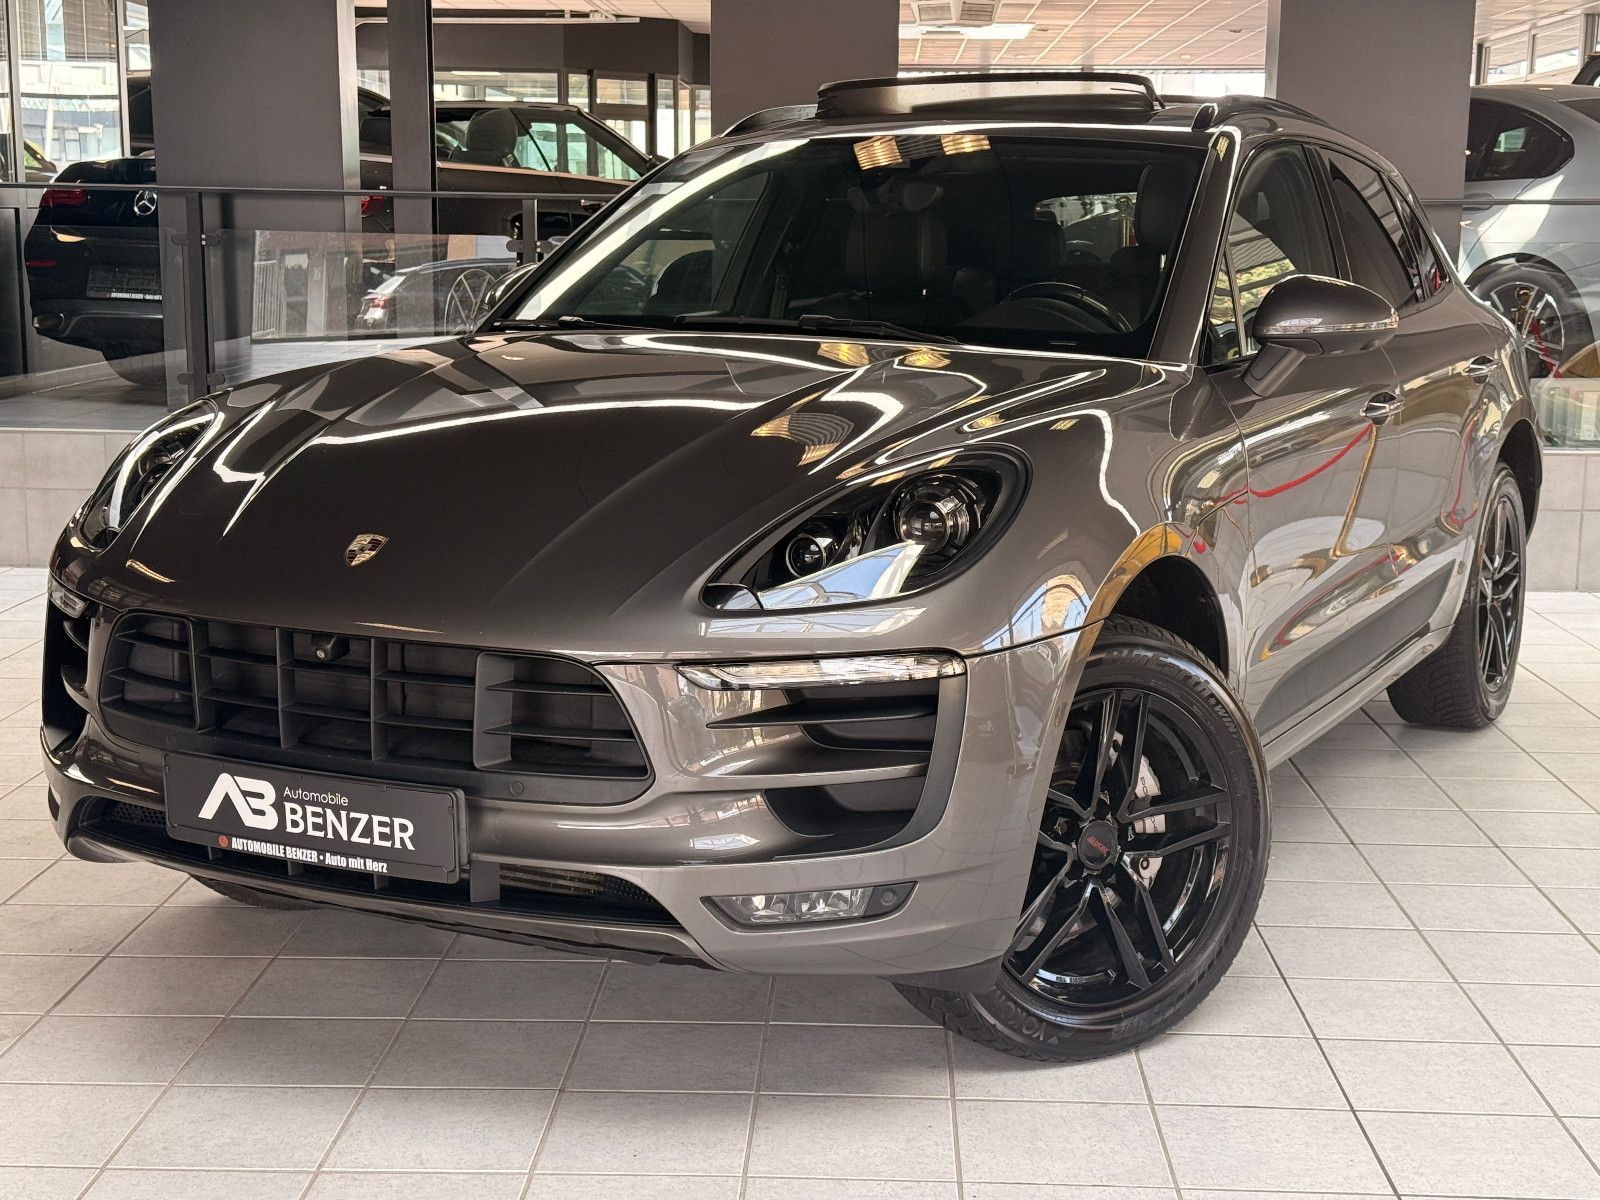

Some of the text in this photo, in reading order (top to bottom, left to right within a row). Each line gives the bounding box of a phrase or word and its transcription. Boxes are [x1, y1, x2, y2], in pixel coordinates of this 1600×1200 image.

[198, 772, 279, 831] AB
[283, 786, 349, 806] Automobile
[283, 801, 416, 851] BENZER
[231, 837, 388, 873] AUTOMOBILE BENZER Auto mit Herz
